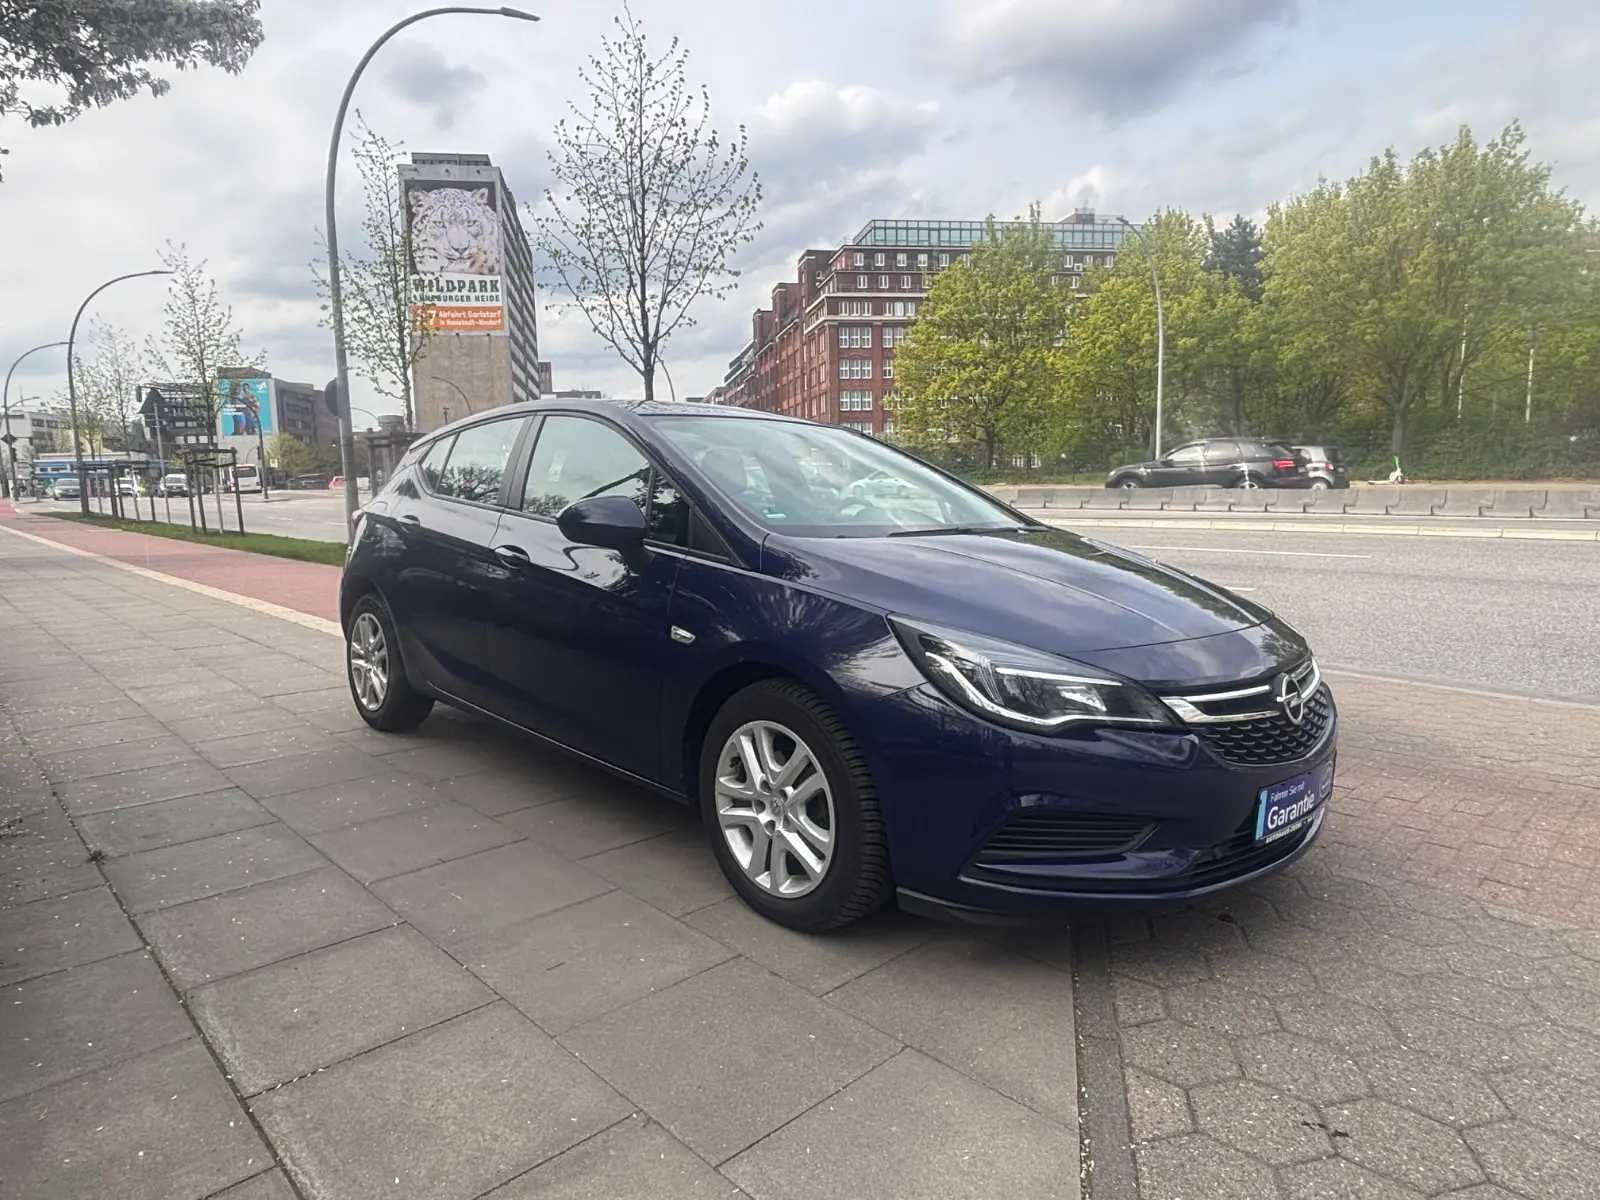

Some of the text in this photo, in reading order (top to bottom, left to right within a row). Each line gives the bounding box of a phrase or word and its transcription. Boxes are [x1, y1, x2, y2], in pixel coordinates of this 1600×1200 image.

[412, 279, 499, 293] WILDPARK
[475, 294, 500, 302] HEIDE
[439, 310, 466, 318] Abfahrt
[1271, 781, 1305, 802] Fahren Sie mit
[1267, 790, 1315, 829] Garantie
